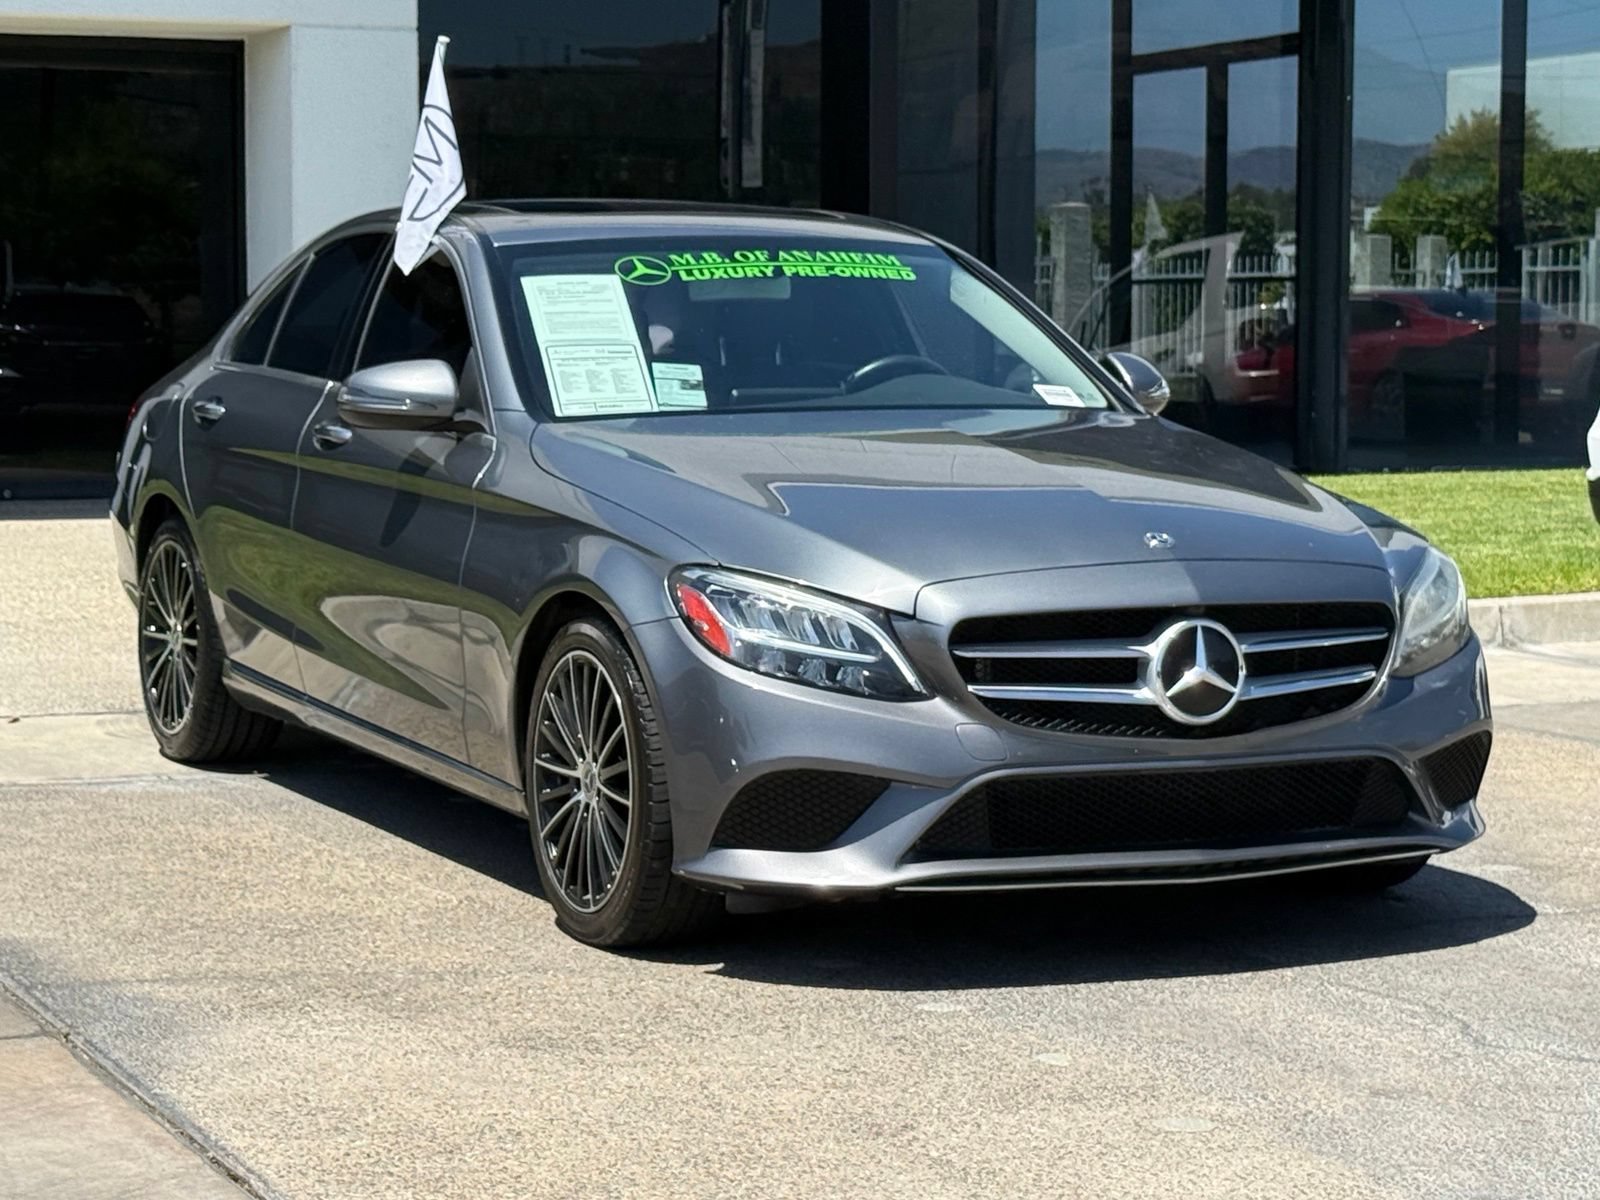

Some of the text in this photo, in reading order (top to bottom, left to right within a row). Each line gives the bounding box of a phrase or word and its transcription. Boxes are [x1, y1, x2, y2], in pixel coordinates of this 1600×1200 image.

[668, 250, 903, 267] M.B. OF ANAHEIM
[678, 265, 917, 282] LUXURY PRE-OWNED
